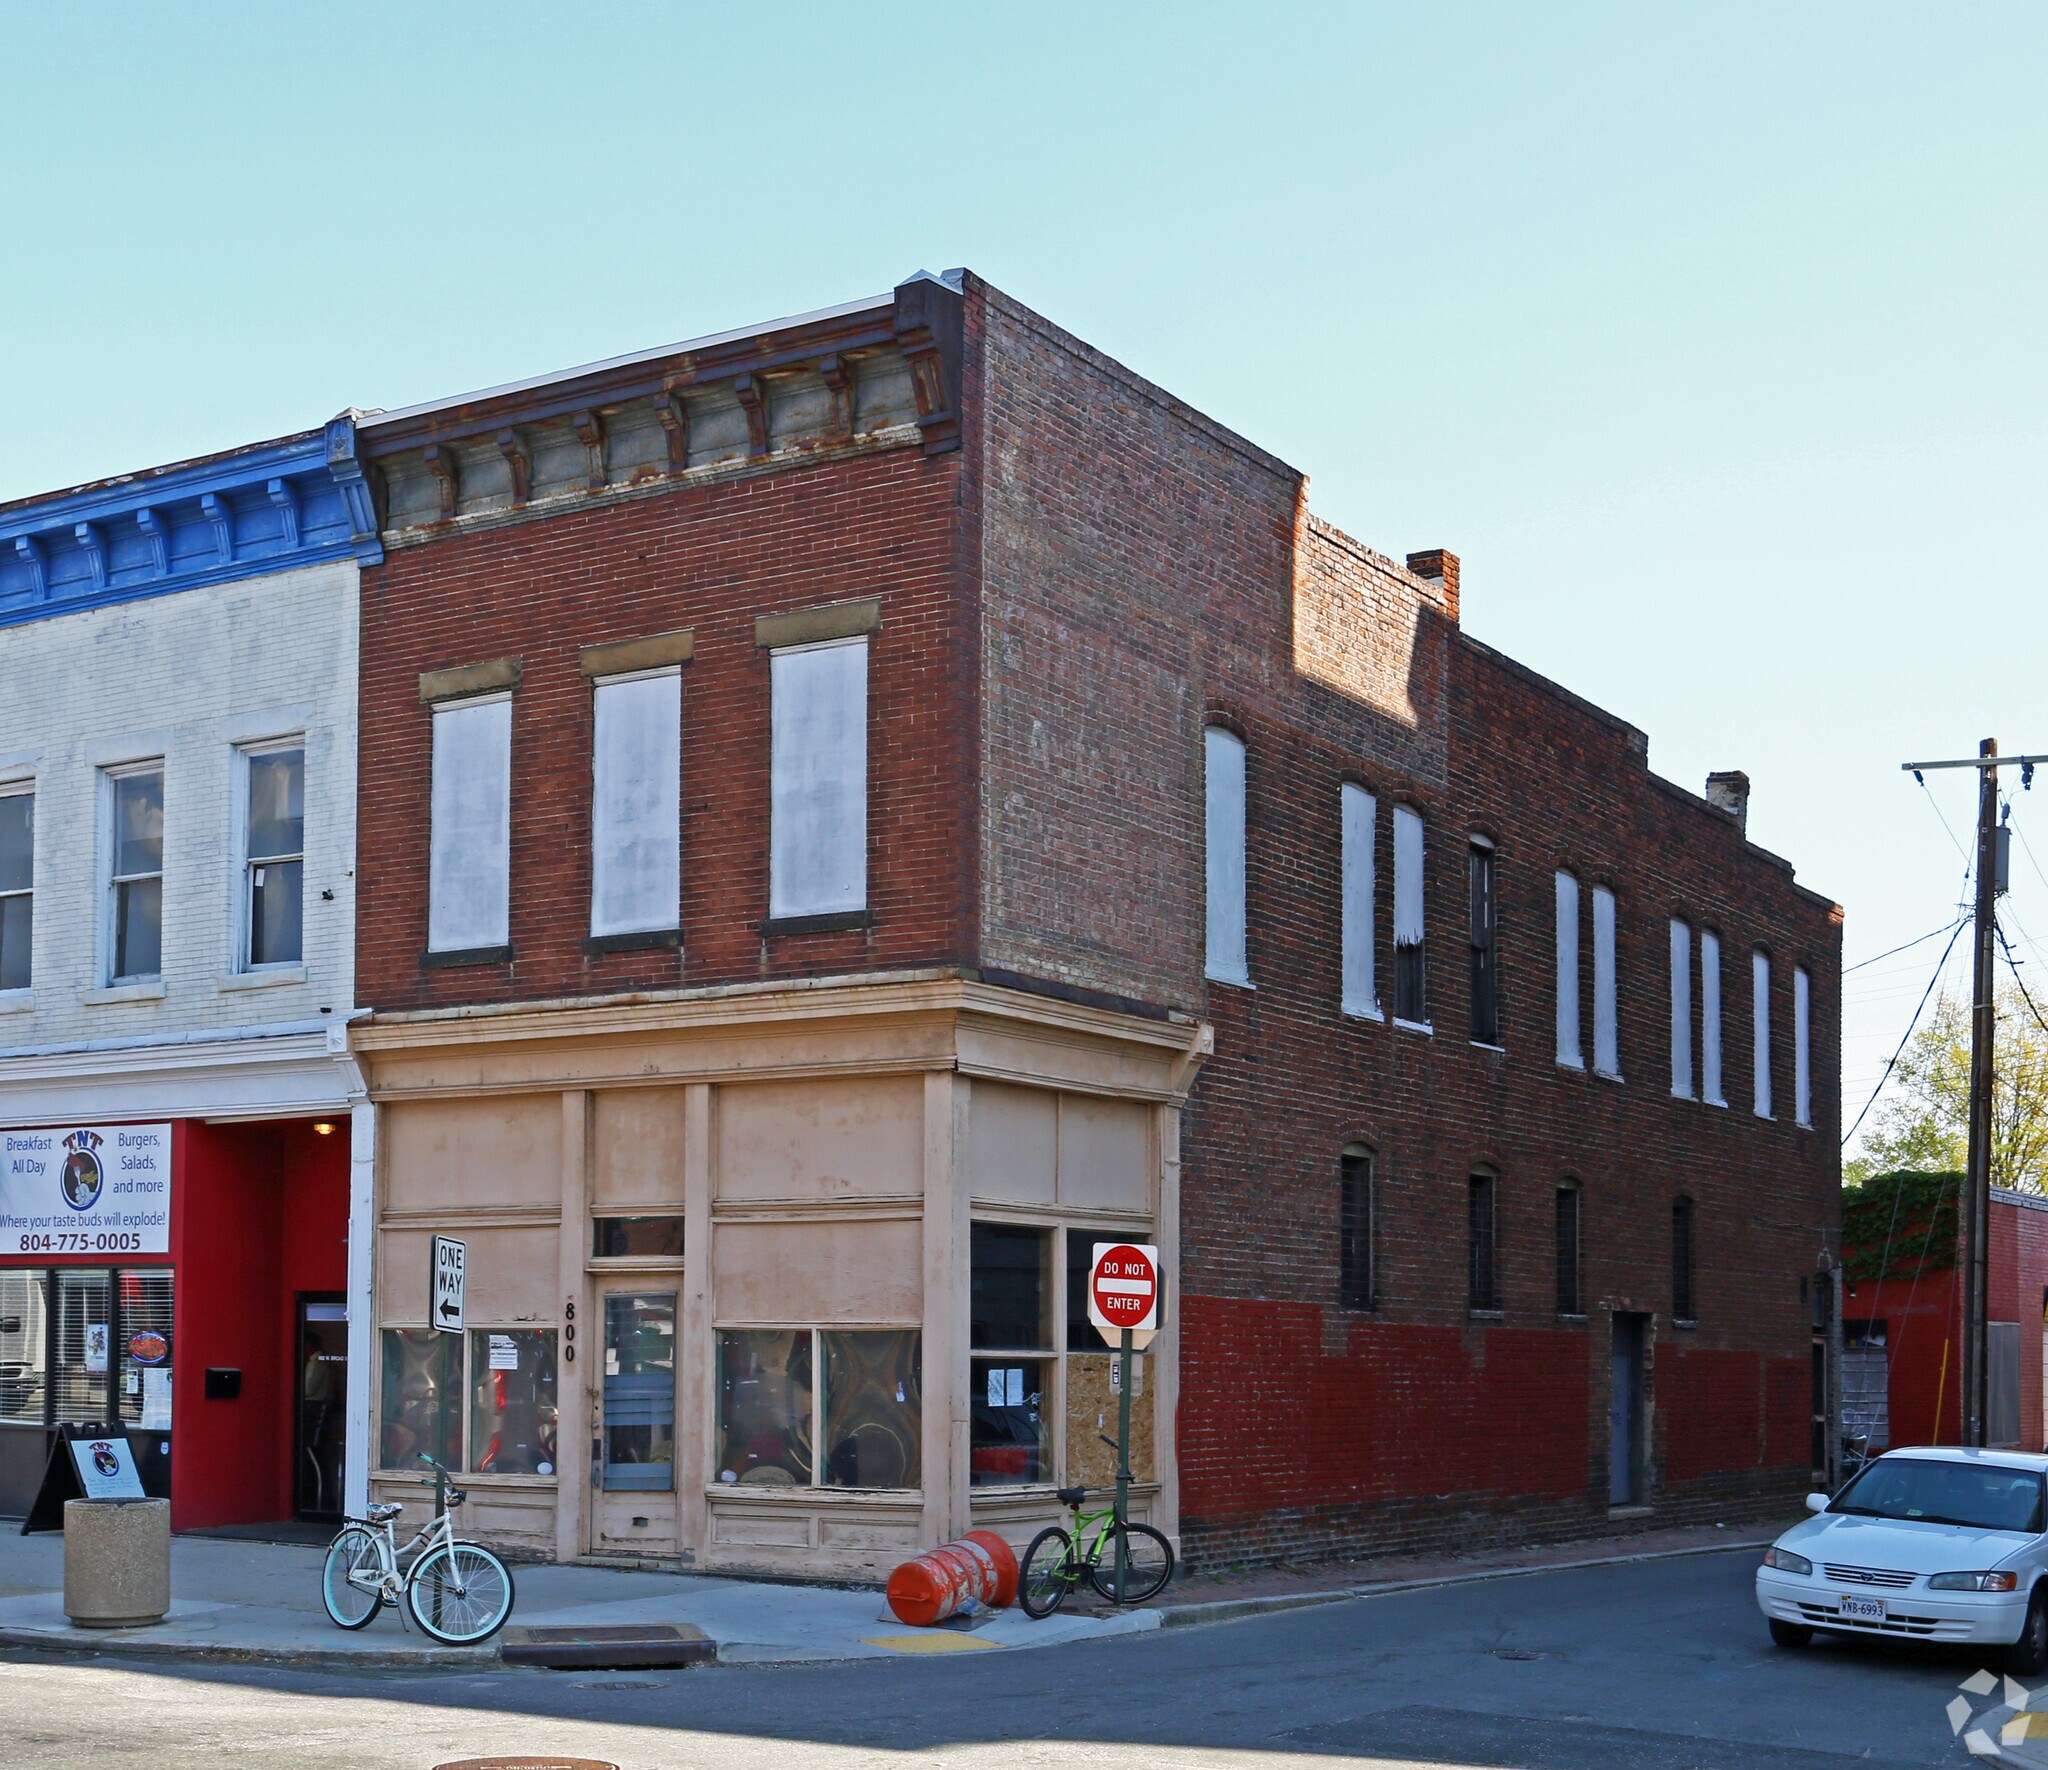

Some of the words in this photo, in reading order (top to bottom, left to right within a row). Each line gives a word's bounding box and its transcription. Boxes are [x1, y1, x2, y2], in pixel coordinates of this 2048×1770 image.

[7, 1135, 52, 1151] Breakfast
[62, 1130, 104, 1150] TNT
[118, 1132, 160, 1150] Burgers,
[12, 1159, 24, 1173] All
[27, 1159, 46, 1176] Day
[121, 1154, 156, 1171] Salads,
[113, 1178, 133, 1193] and
[136, 1181, 163, 1193] more
[0, 1214, 28, 1228] Where
[30, 1217, 51, 1231] your
[53, 1214, 76, 1227] taste
[78, 1212, 102, 1227] buds
[104, 1211, 121, 1226] will
[123, 1211, 165, 1229] explode!
[20, 1233, 141, 1251] 804-775-0005
[440, 1245, 462, 1269] ONE
[1104, 1262, 1119, 1275] DO
[1124, 1263, 1146, 1276] NOT
[439, 1270, 462, 1295] WAY
[1107, 1296, 1140, 1311] ENTER
[565, 1302, 575, 1362] 800
[1841, 1601, 1883, 1617] WNB-6993
